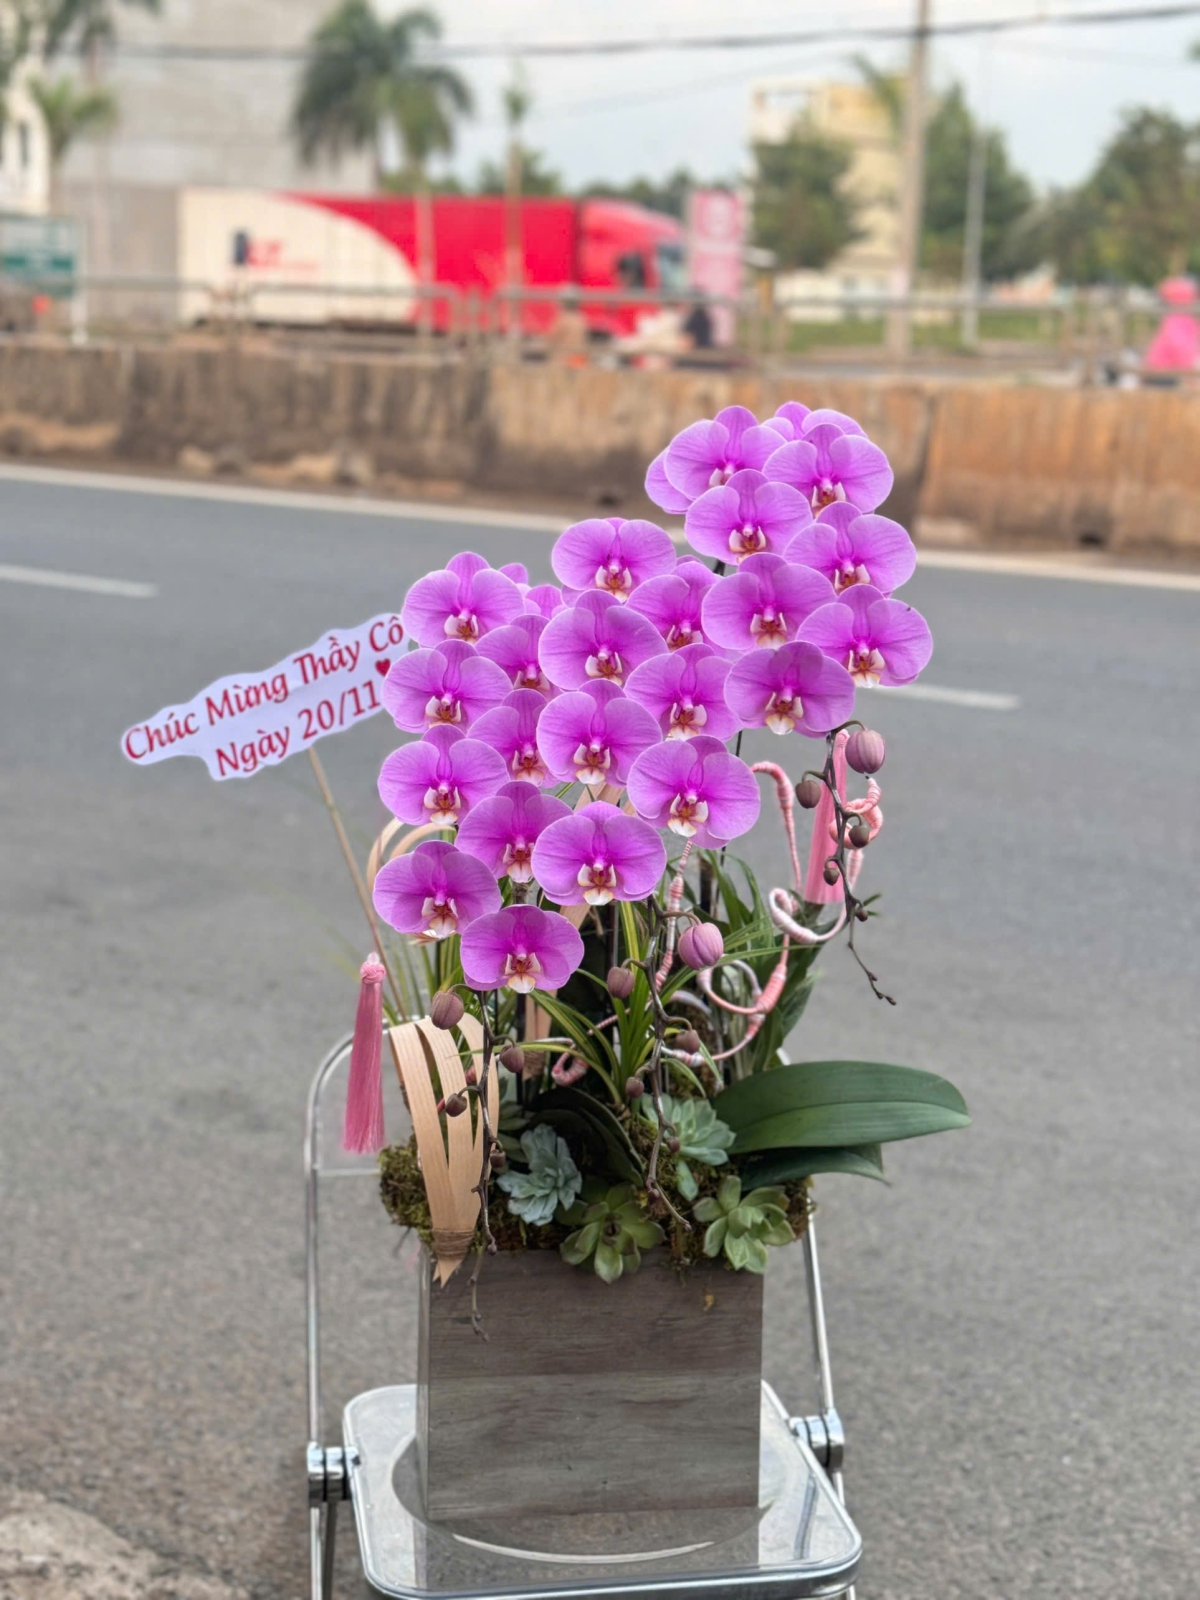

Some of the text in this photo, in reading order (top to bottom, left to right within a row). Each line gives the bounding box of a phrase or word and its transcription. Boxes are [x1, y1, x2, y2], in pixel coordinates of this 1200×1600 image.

[125, 615, 404, 760] Chúc Mừng Thầy Cô
[214, 680, 381, 777] Ngày 20/11
